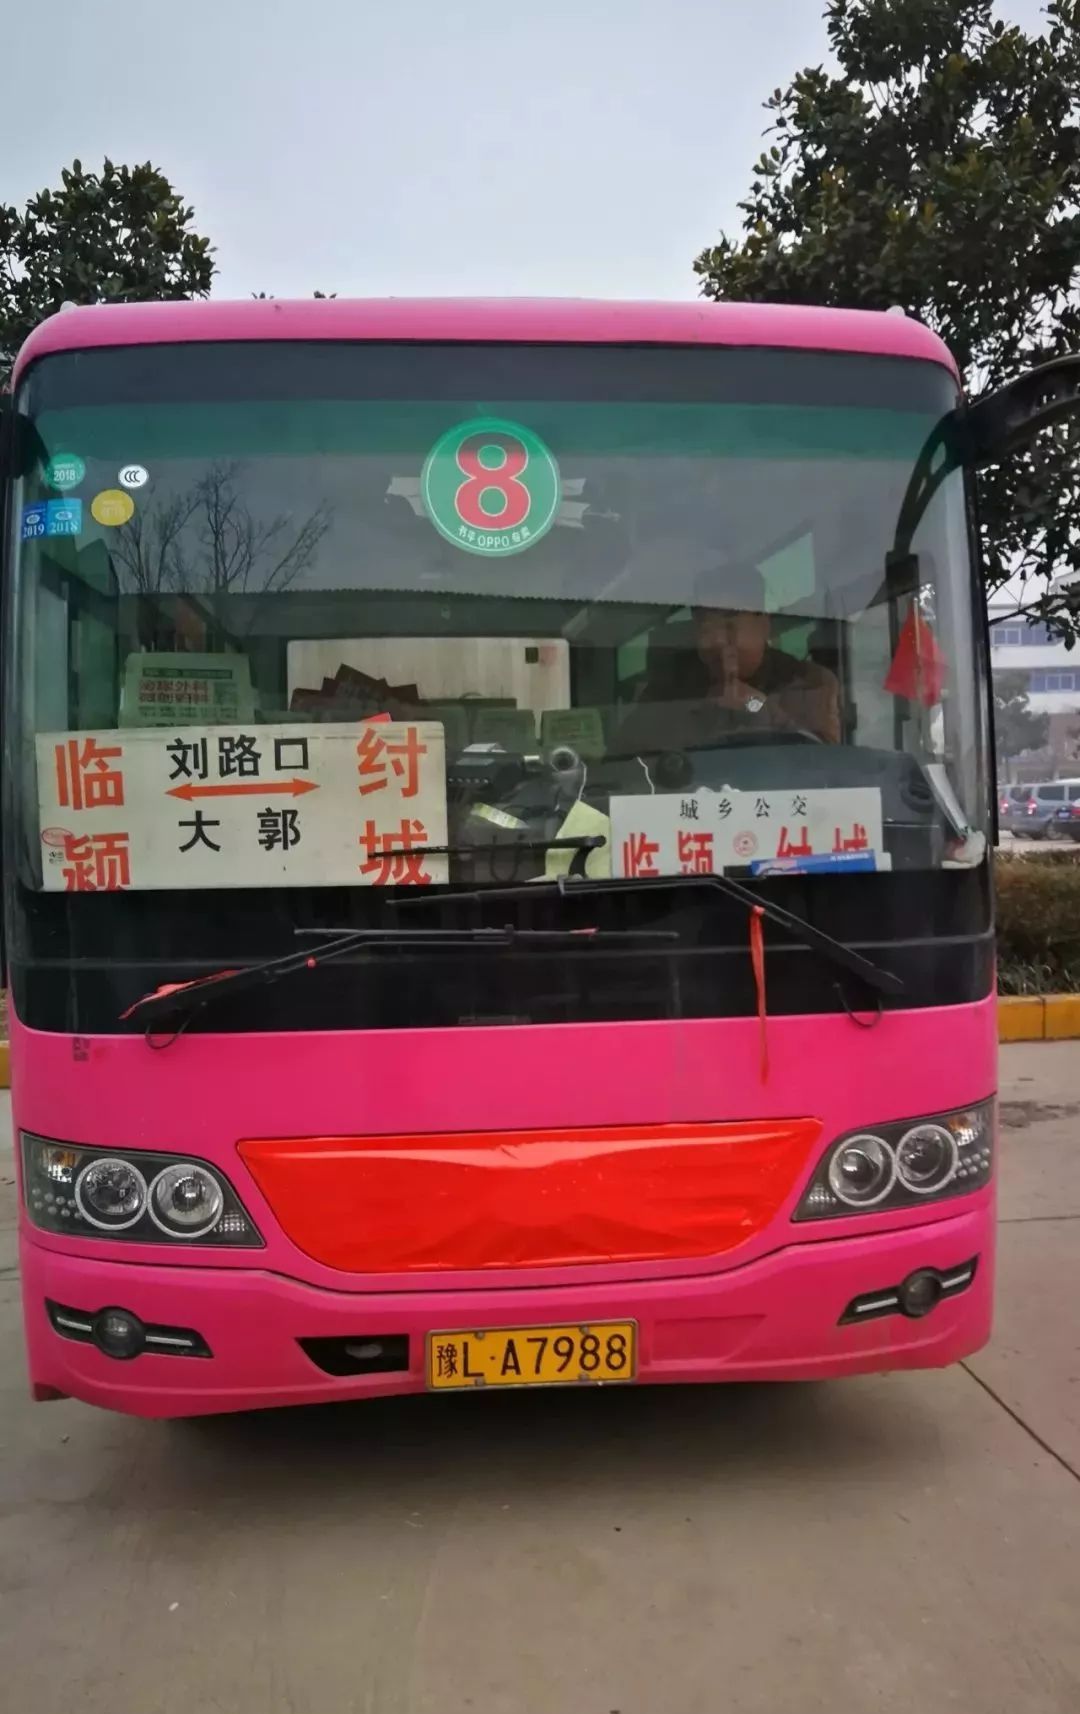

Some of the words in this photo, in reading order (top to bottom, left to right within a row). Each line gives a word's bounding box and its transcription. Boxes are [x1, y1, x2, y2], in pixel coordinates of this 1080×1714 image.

[53, 469, 76, 482] 2018
[455, 431, 531, 530] 8
[24, 524, 45, 538] 2019
[51, 521, 79, 534] 2018
[478, 535, 510, 548] OPPO
[166, 734, 311, 780] 刘路口
[356, 727, 433, 886] 纣城
[680, 795, 808, 820] 城乡公交
[178, 808, 302, 853] 大郭
